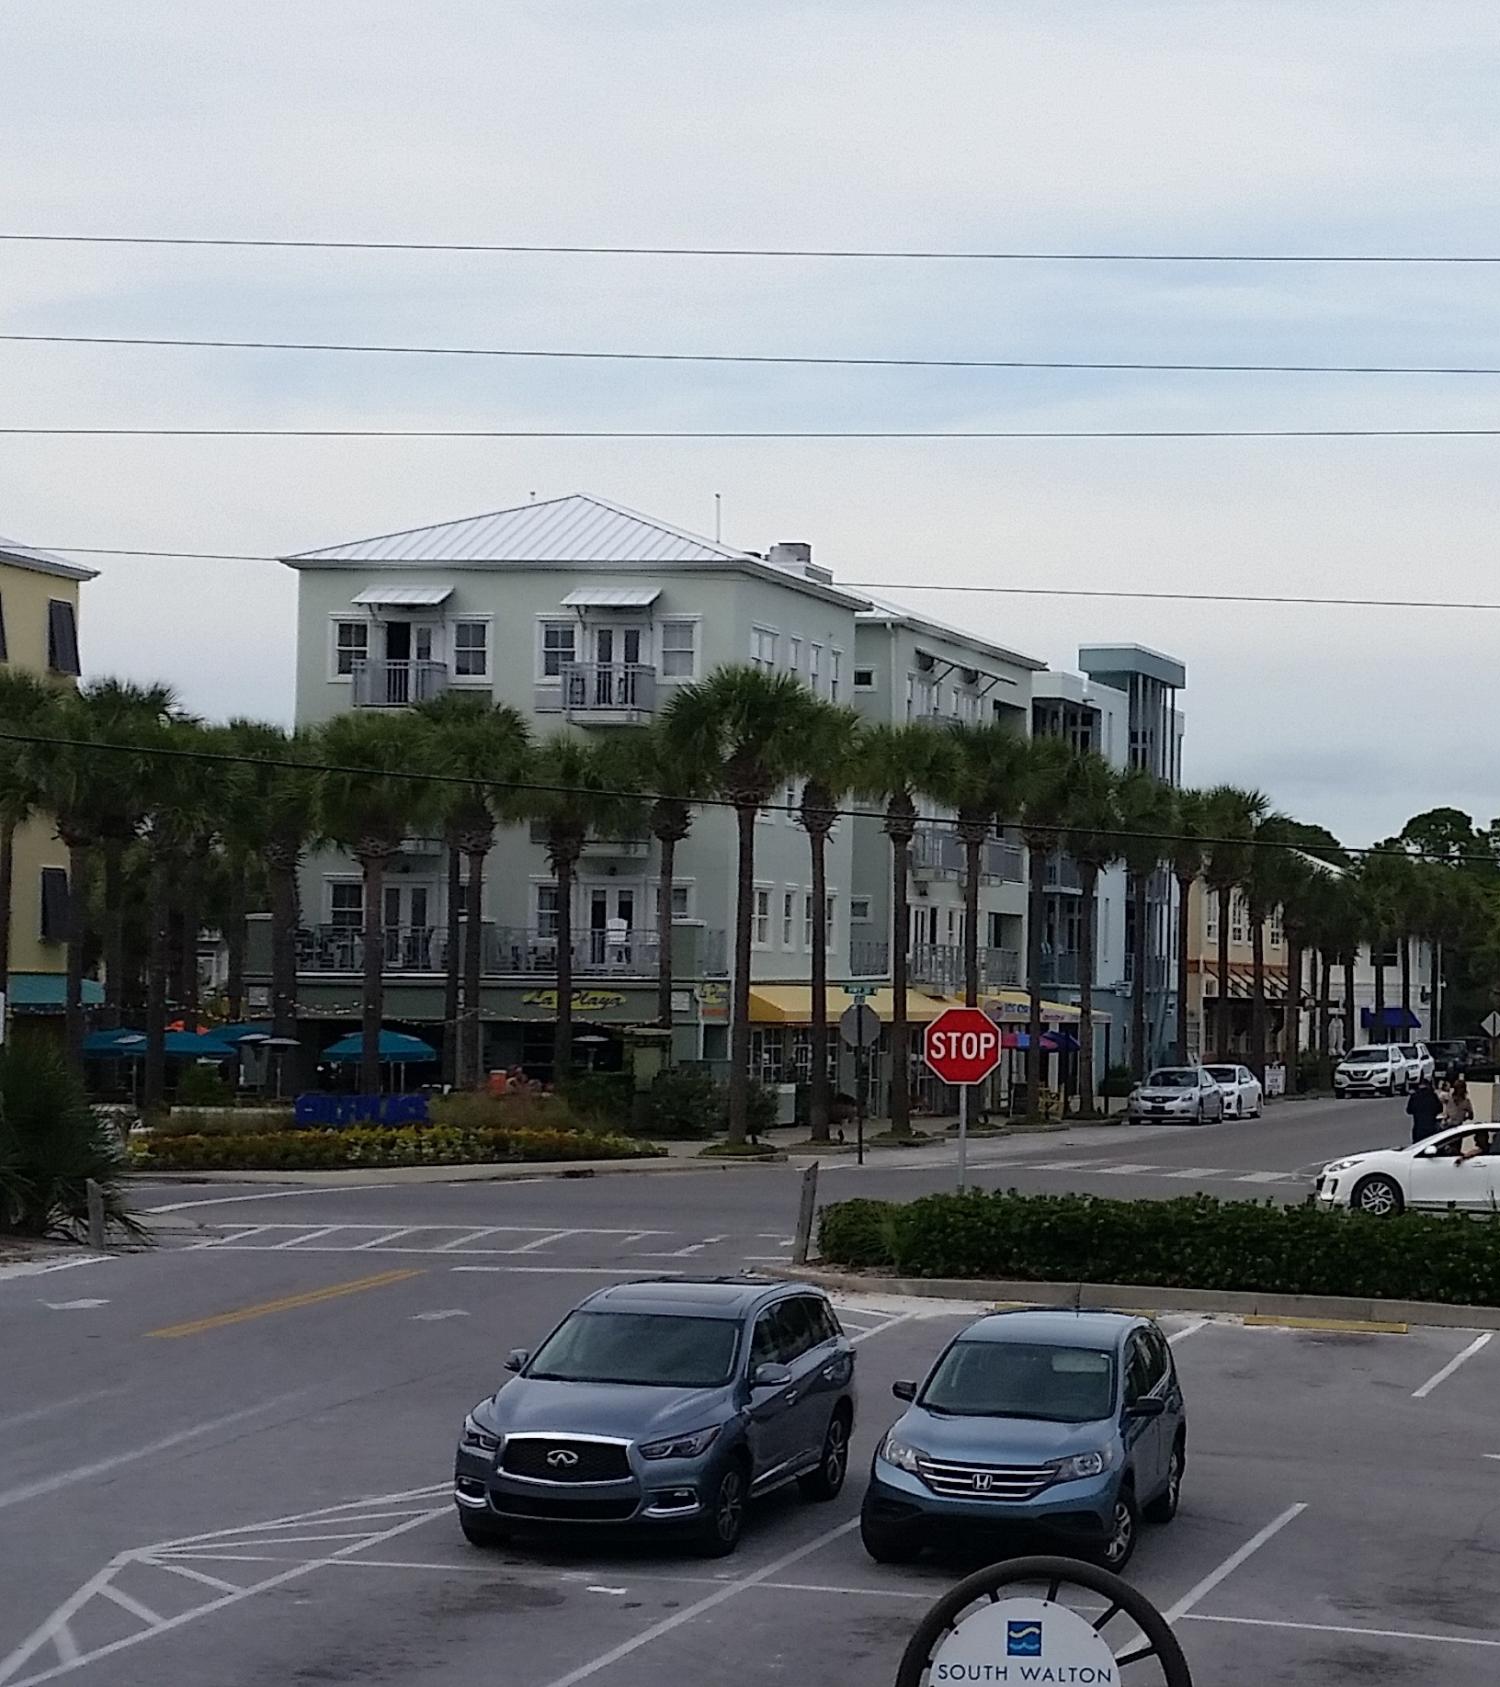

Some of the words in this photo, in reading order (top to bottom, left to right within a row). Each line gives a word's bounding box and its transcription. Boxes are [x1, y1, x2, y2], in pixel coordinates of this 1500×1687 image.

[930, 1032, 996, 1060] STOP
[937, 1664, 1008, 1682] SOUTH
[1020, 1666, 1112, 1683] WALTON
